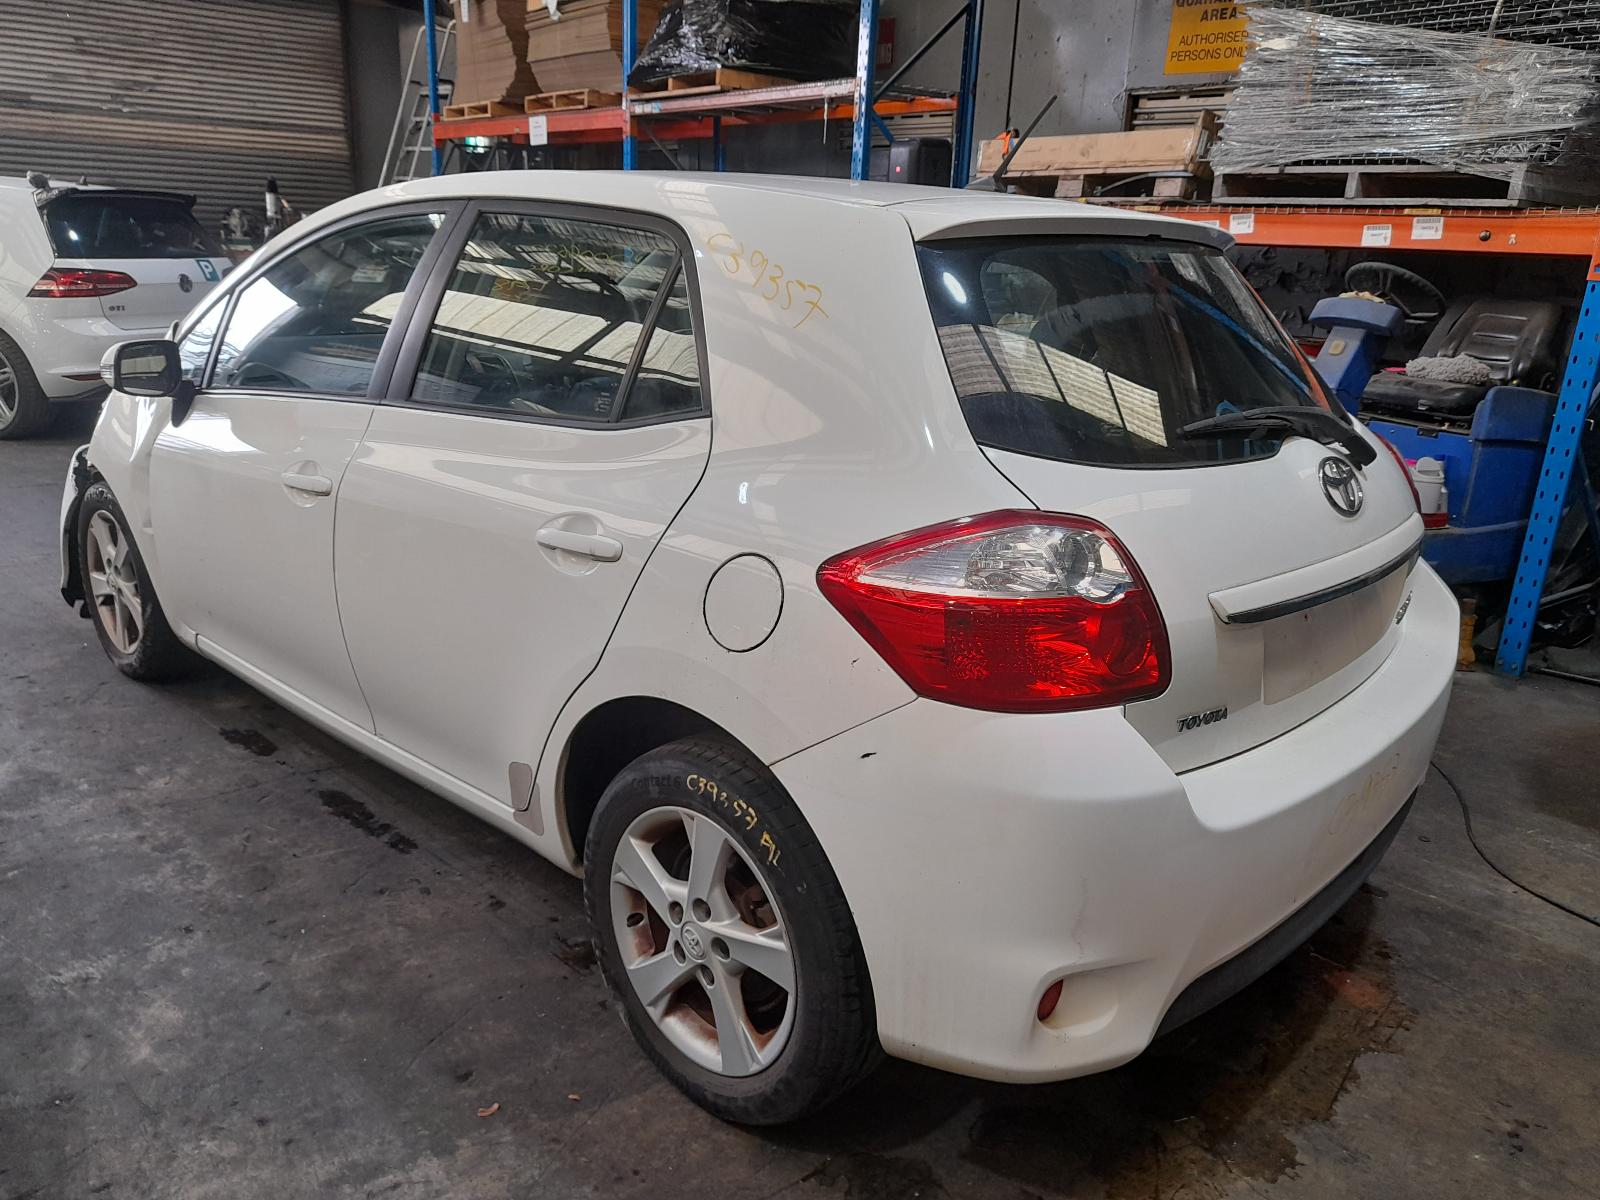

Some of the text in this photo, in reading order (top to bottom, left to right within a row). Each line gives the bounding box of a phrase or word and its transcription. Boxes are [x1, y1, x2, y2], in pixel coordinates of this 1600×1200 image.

[1200, 7, 1237, 21] AREA
[1170, 46, 1248, 61] PERSONS ONL
[199, 260, 214, 279] P
[1177, 706, 1228, 732] TOYOTA
